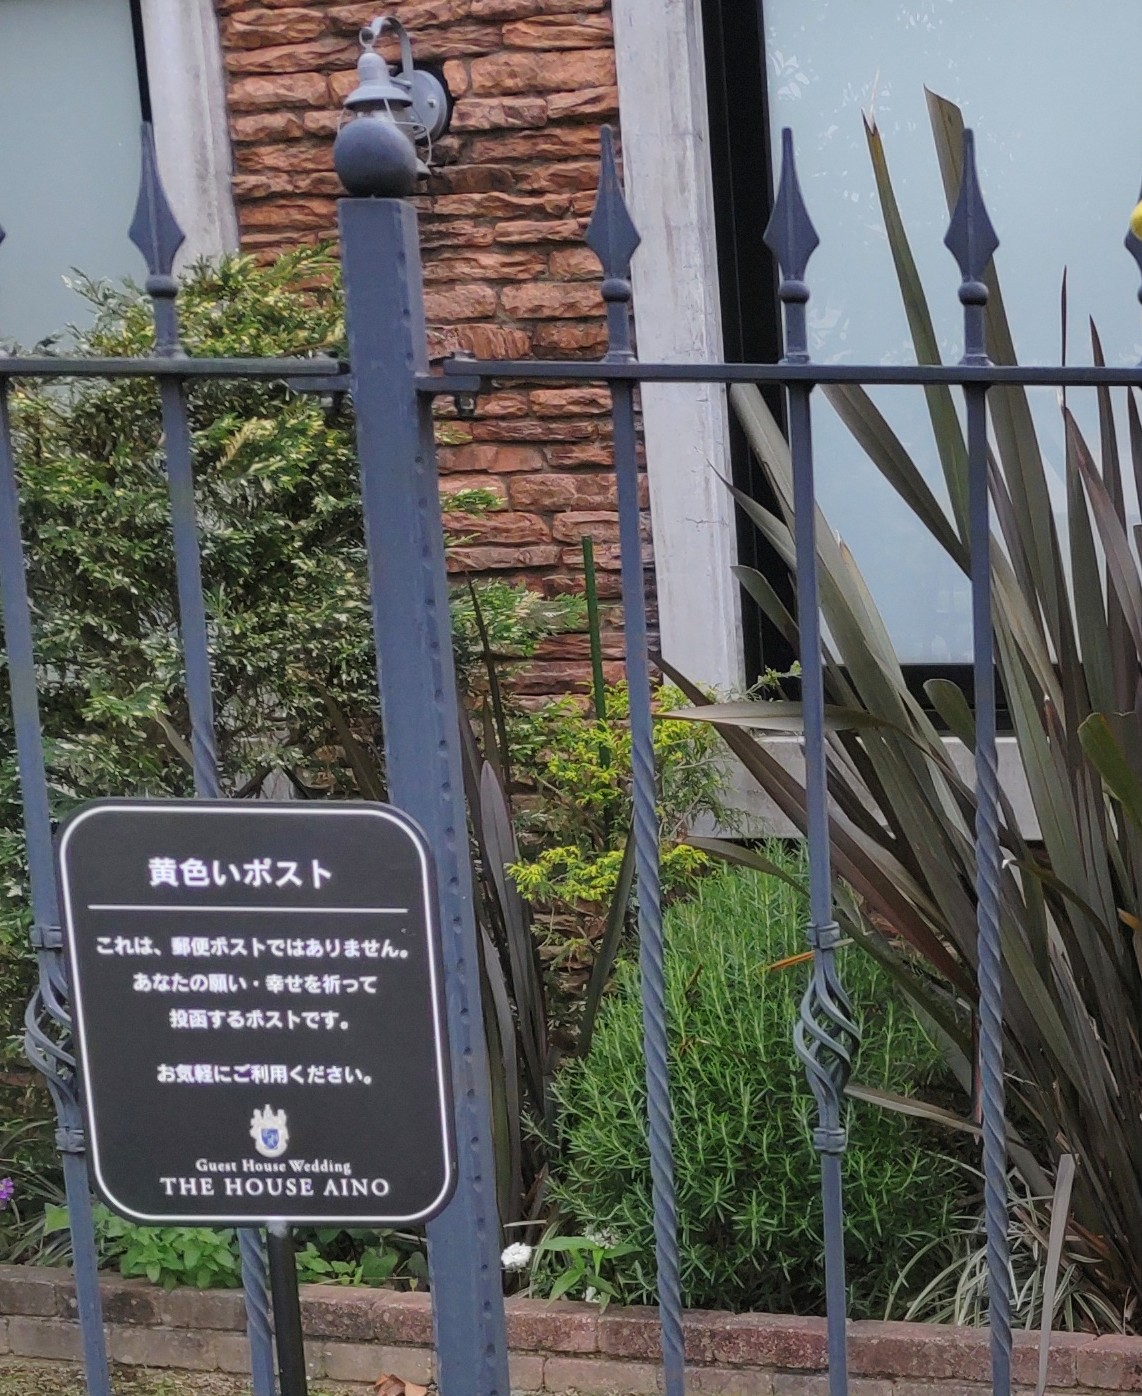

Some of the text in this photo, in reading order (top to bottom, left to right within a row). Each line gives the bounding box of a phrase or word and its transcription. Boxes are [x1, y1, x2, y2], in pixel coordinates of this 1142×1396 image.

[148, 857, 333, 889] 黄色いポスト
[96, 935, 409, 959] これは、郵便ポストではありません。
[169, 1008, 349, 1031] 投函するポストです。
[157, 1064, 373, 1086] お気軽にご利用ください。
[196, 1159, 352, 1176] Guest House Wedding
[160, 1177, 390, 1196] THE HOUSE AINO
